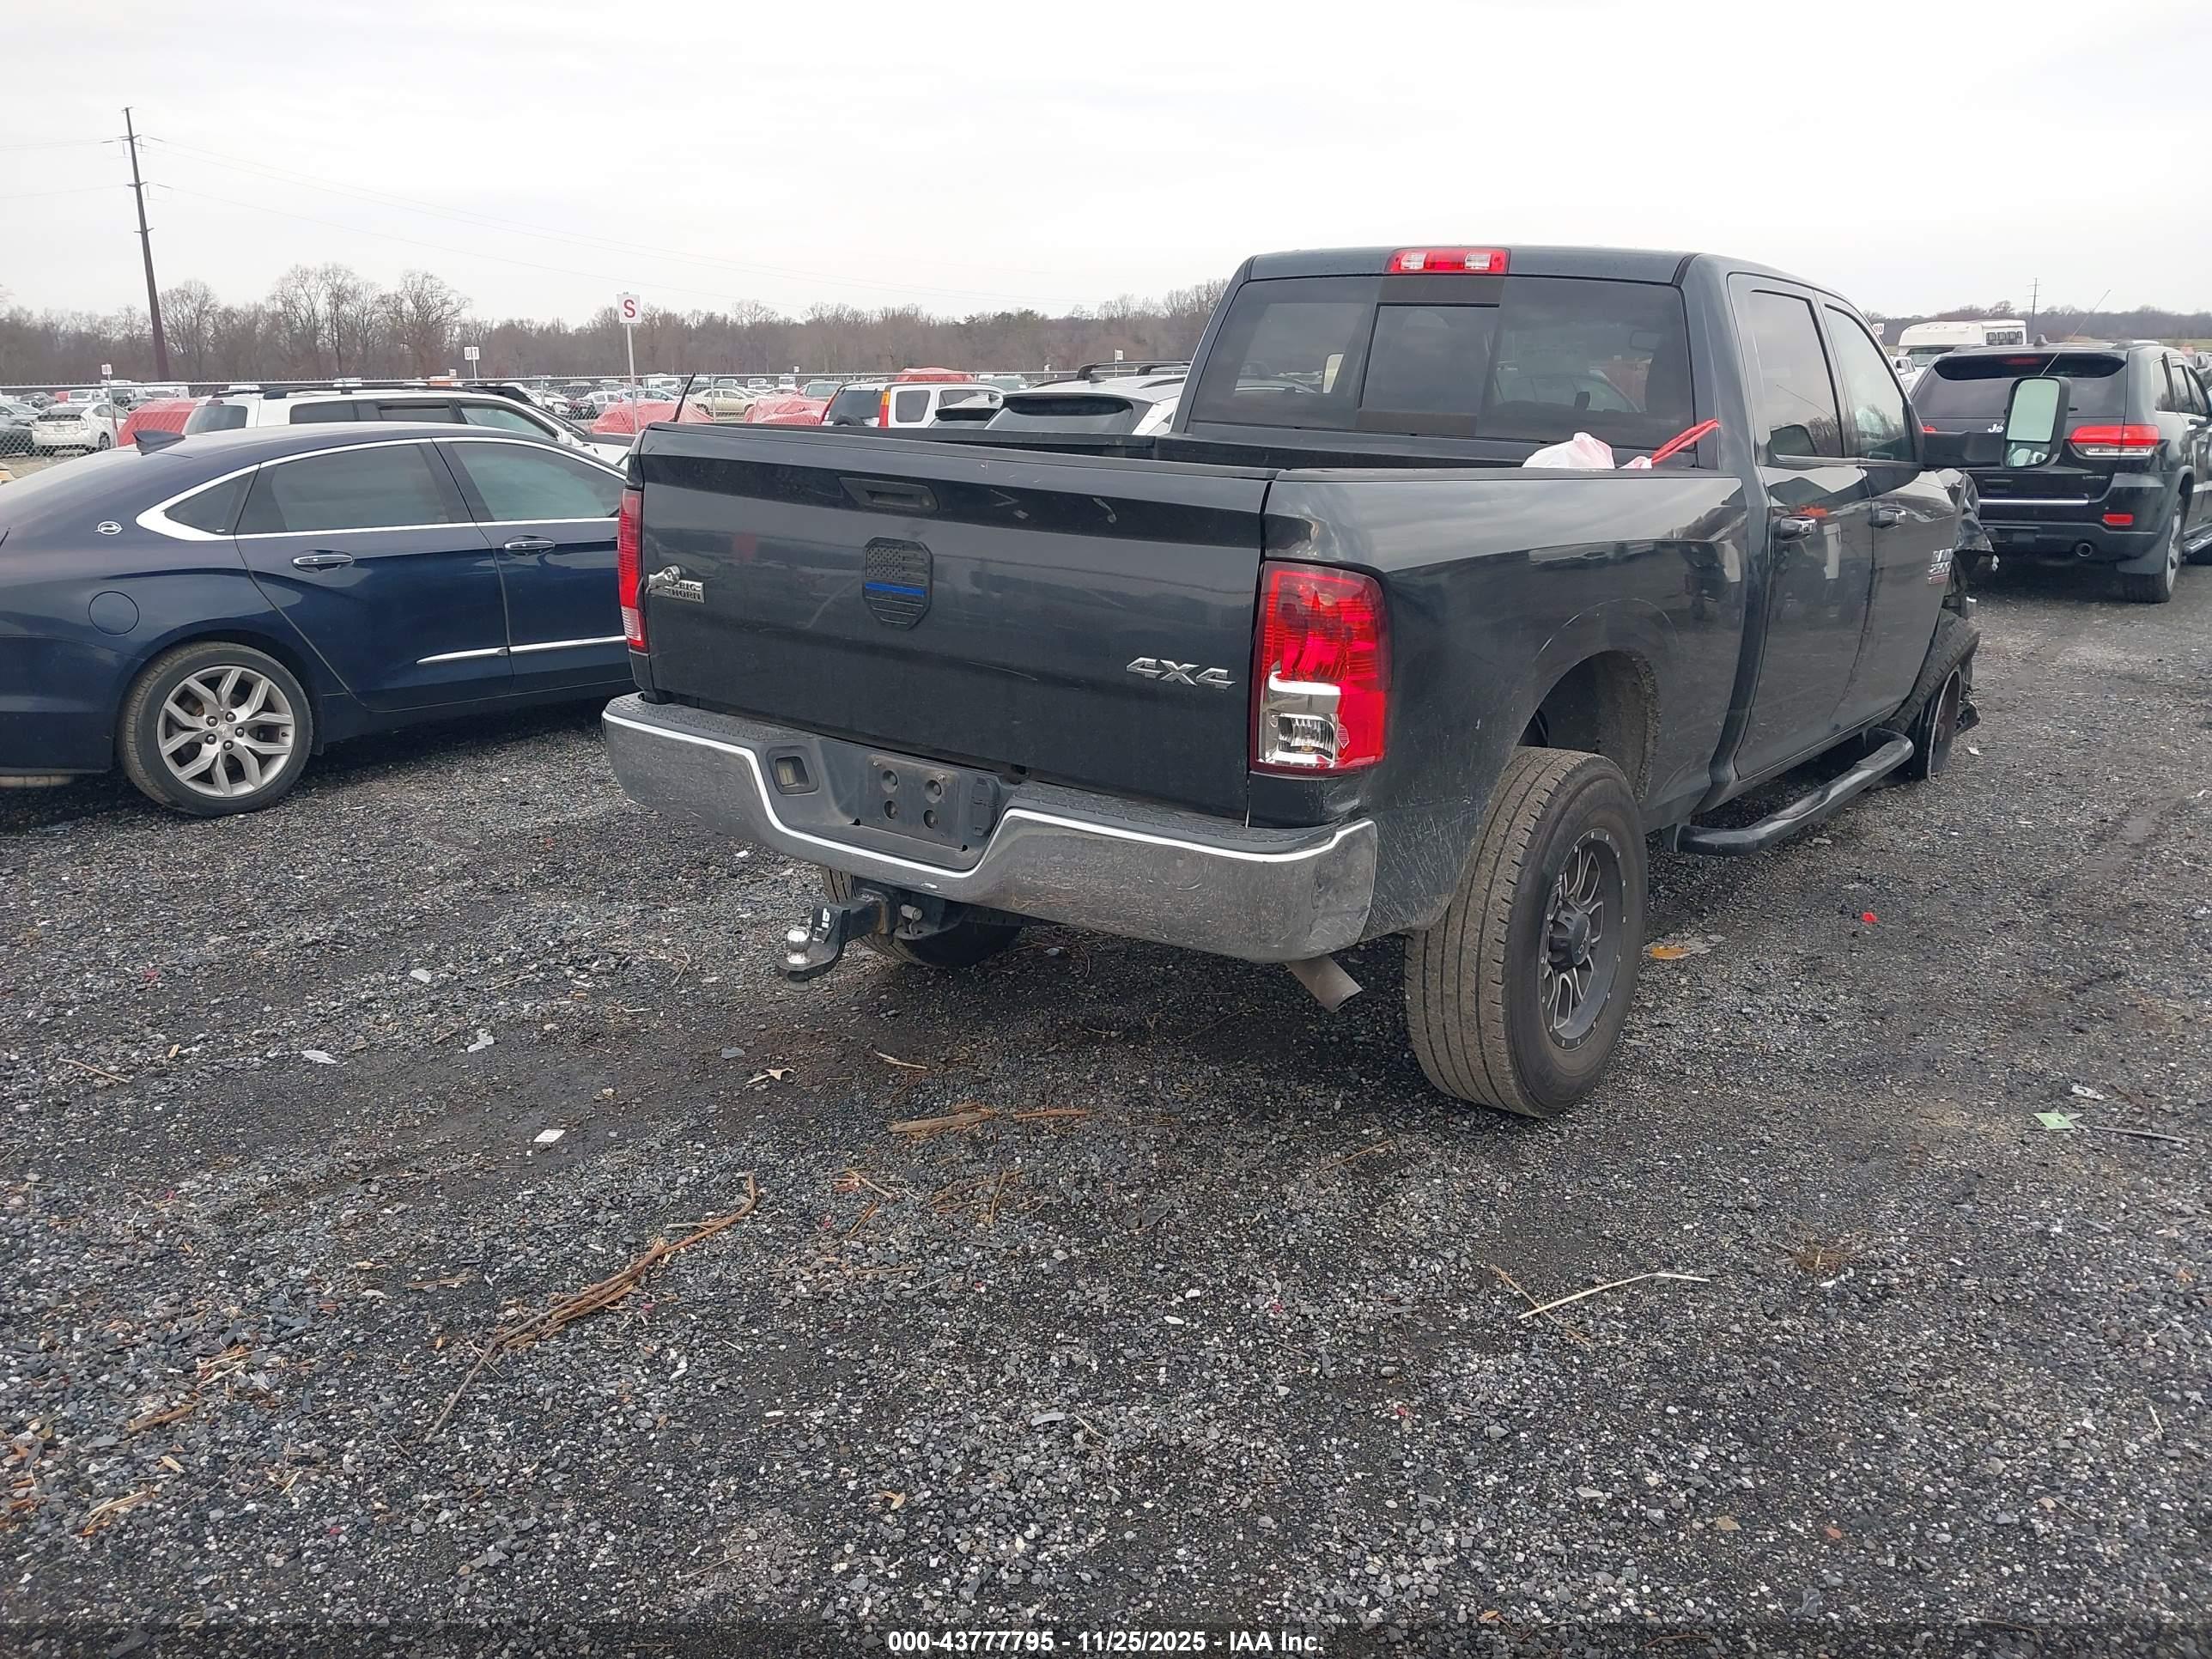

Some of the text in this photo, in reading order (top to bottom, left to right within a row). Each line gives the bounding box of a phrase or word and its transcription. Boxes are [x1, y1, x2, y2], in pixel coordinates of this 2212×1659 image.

[623, 299, 636, 319] S
[678, 581, 696, 592] BIG
[672, 588, 701, 600] HORN
